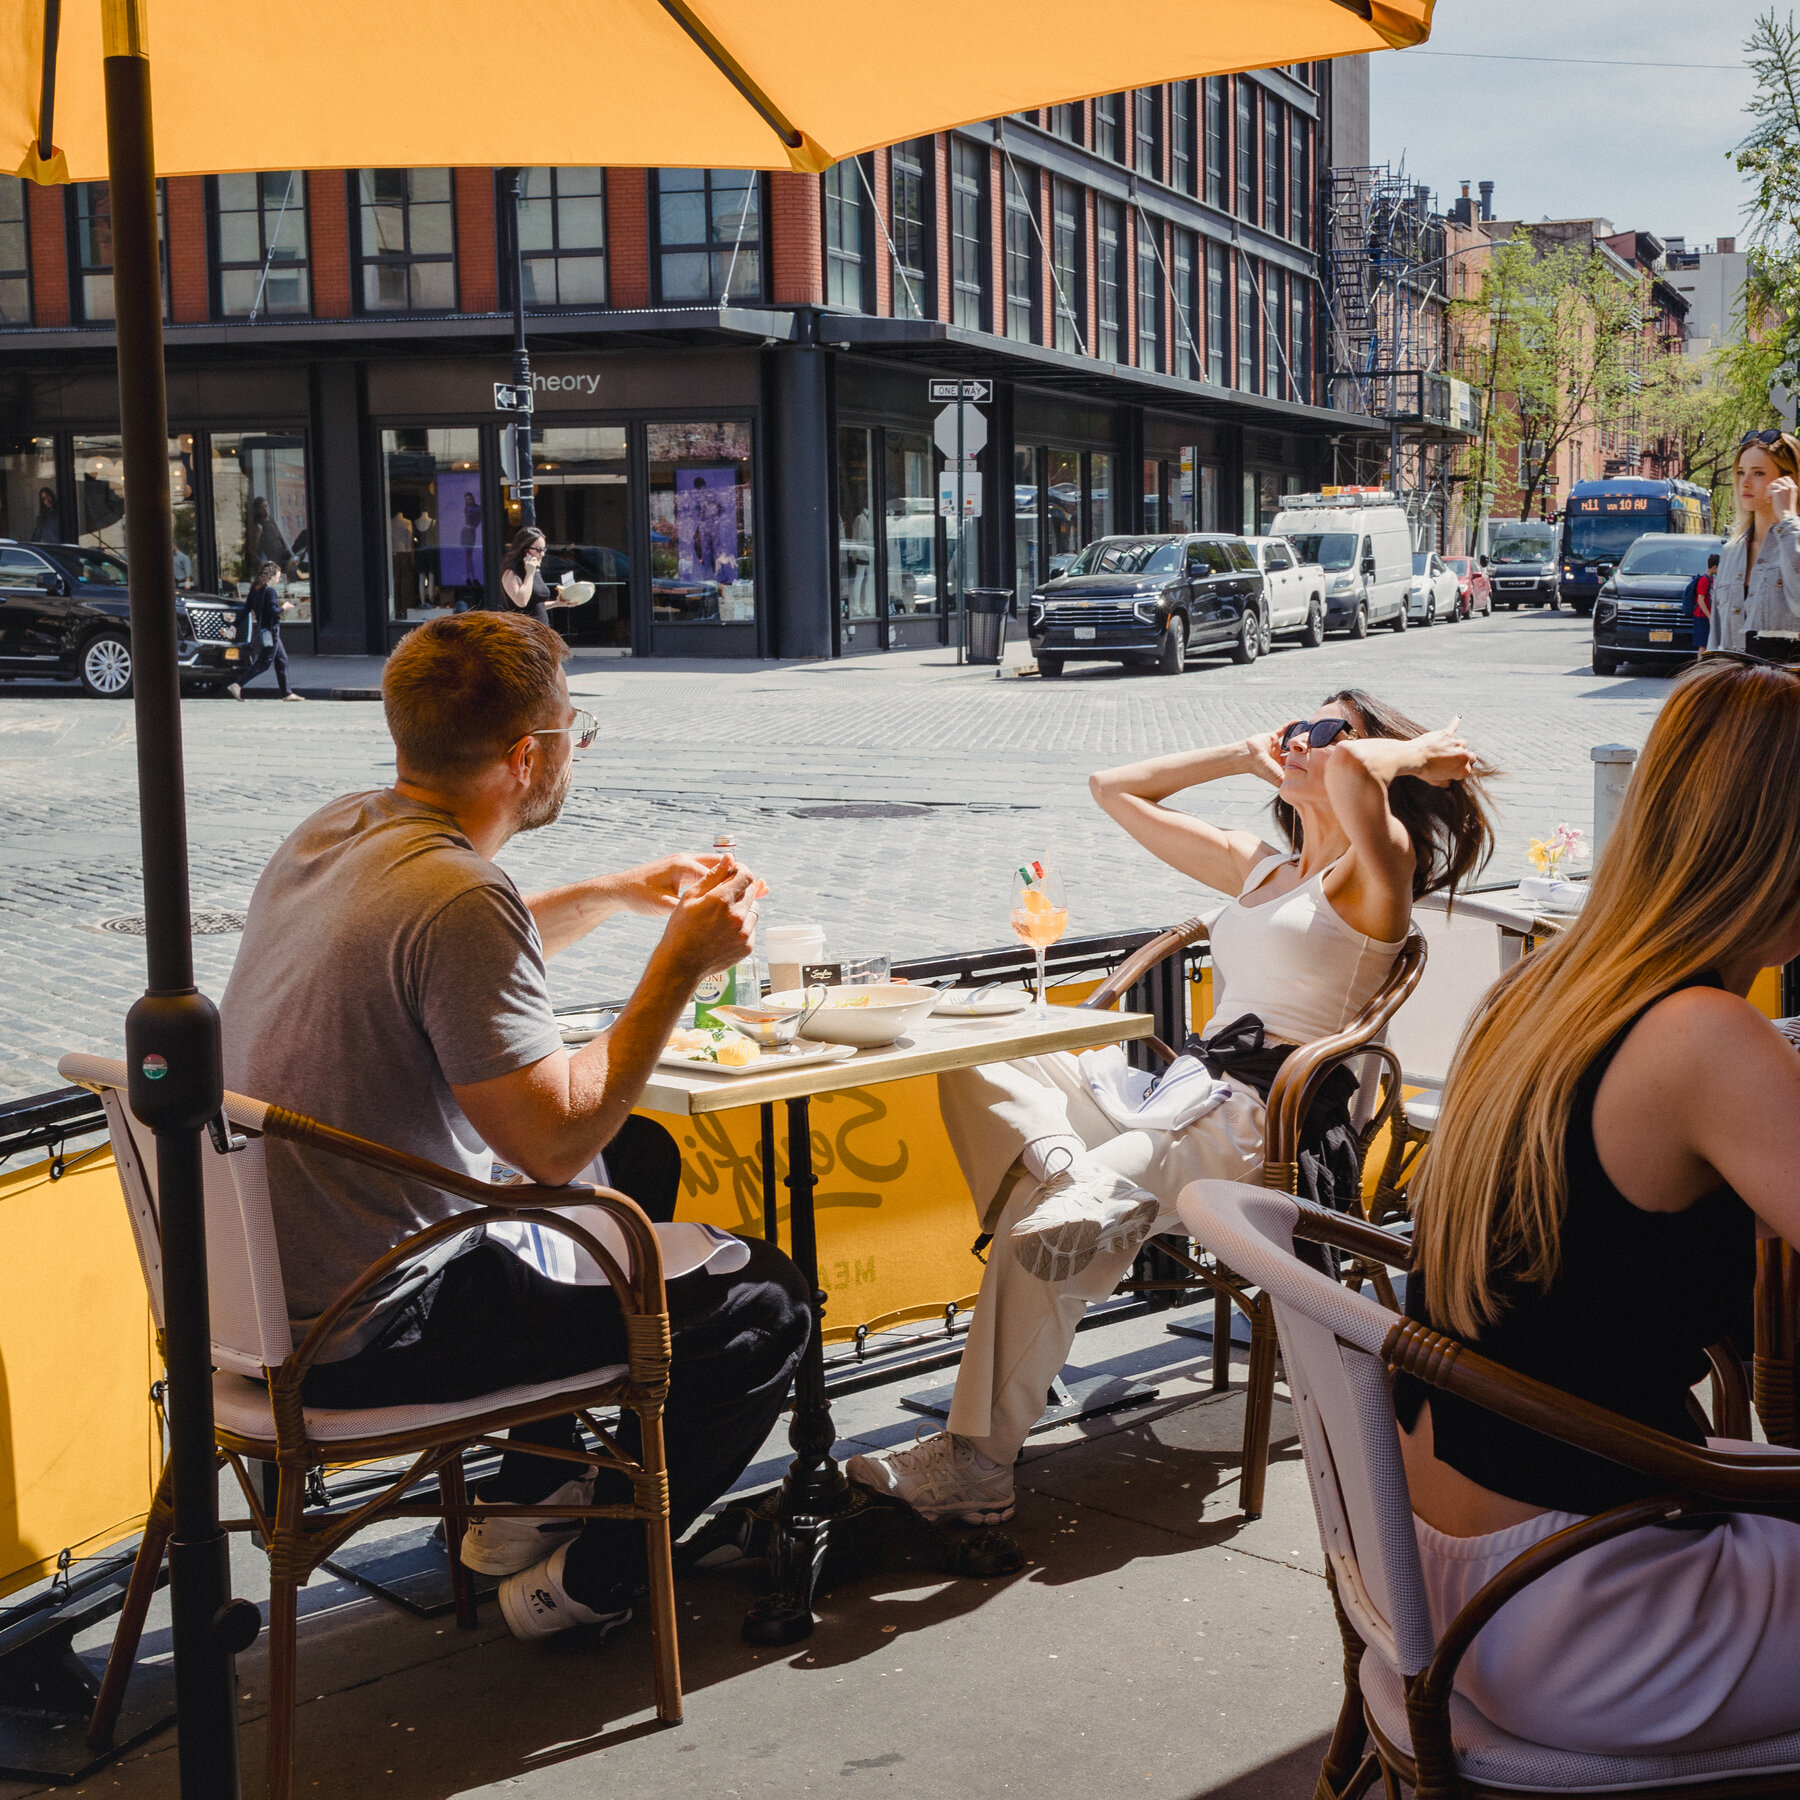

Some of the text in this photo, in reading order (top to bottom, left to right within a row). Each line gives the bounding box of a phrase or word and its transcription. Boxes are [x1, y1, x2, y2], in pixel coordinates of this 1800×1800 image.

[529, 372, 601, 394] heory
[938, 386, 982, 396] ONE WAY
[1620, 499, 1632, 510] 10
[1634, 499, 1648, 510] AV
[703, 974, 723, 983] ONI
[530, 1594, 544, 1615] AIR
